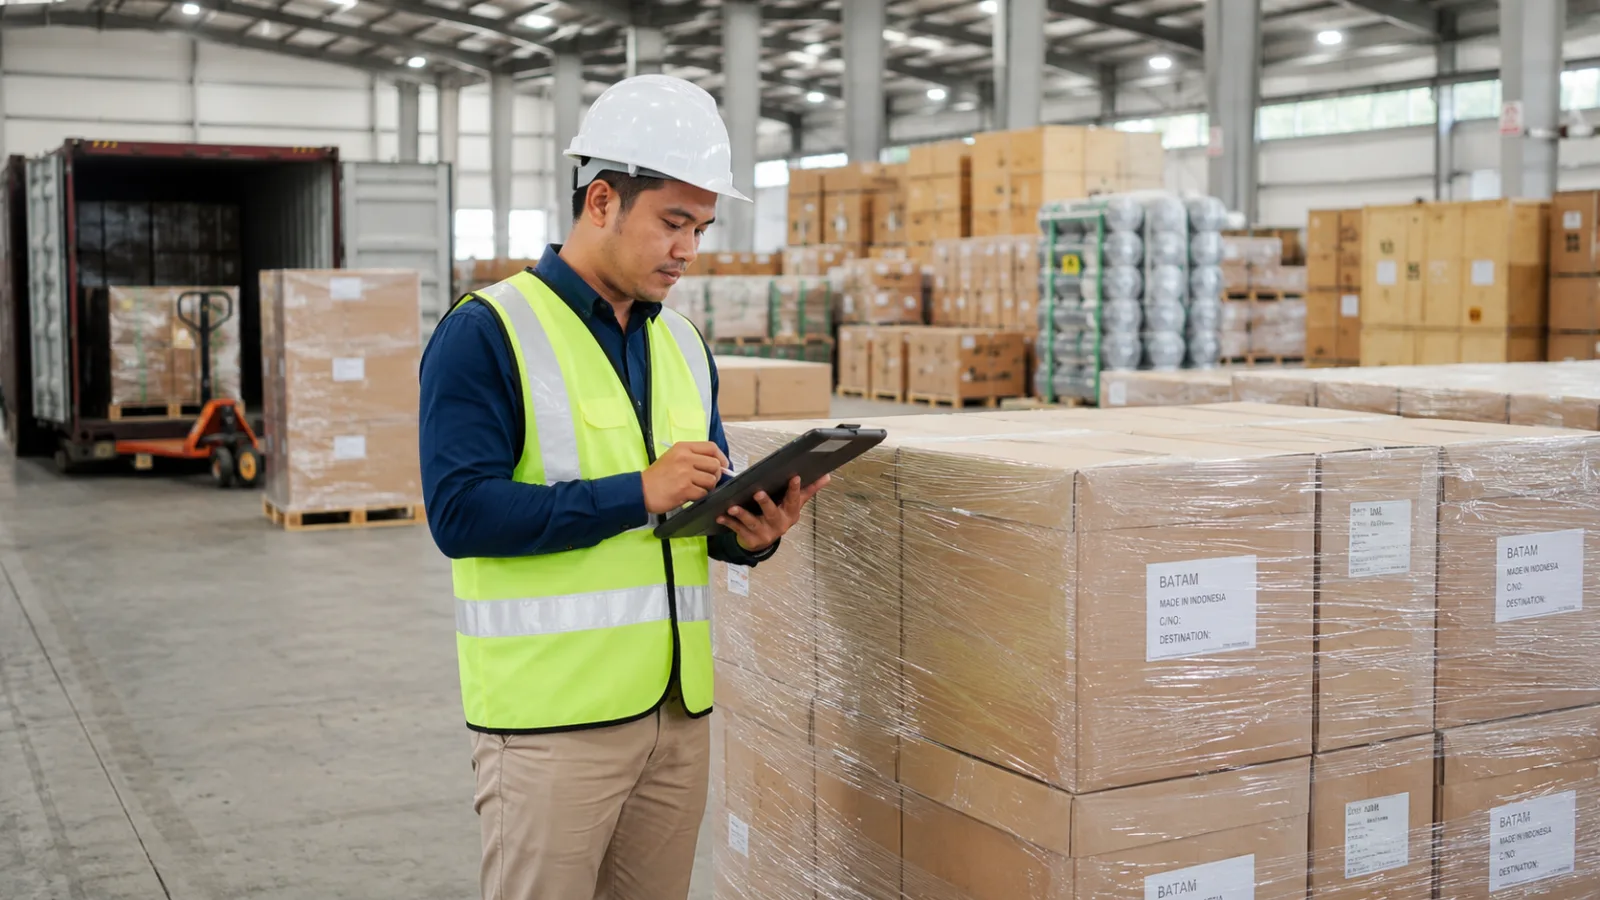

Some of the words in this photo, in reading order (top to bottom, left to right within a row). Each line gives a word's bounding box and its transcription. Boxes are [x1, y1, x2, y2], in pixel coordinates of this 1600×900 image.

[1507, 544, 1538, 559] BATAM
[1507, 567, 1523, 576] MADE
[1523, 566, 1530, 574] IN
[1530, 562, 1559, 572] INDONESIA
[1160, 573, 1199, 588] BATAM
[1160, 598, 1180, 608] MADE
[1181, 597, 1189, 606] IN
[1190, 593, 1226, 605] INDONESIA
[1159, 615, 1181, 627] C/NO:
[1160, 630, 1211, 645] DESTINATION:
[1500, 811, 1531, 828] BATAM
[1499, 834, 1516, 845] MADE
[1516, 832, 1522, 841] IN
[1523, 826, 1551, 839] INDONESIA
[1158, 879, 1197, 899] BATAM
